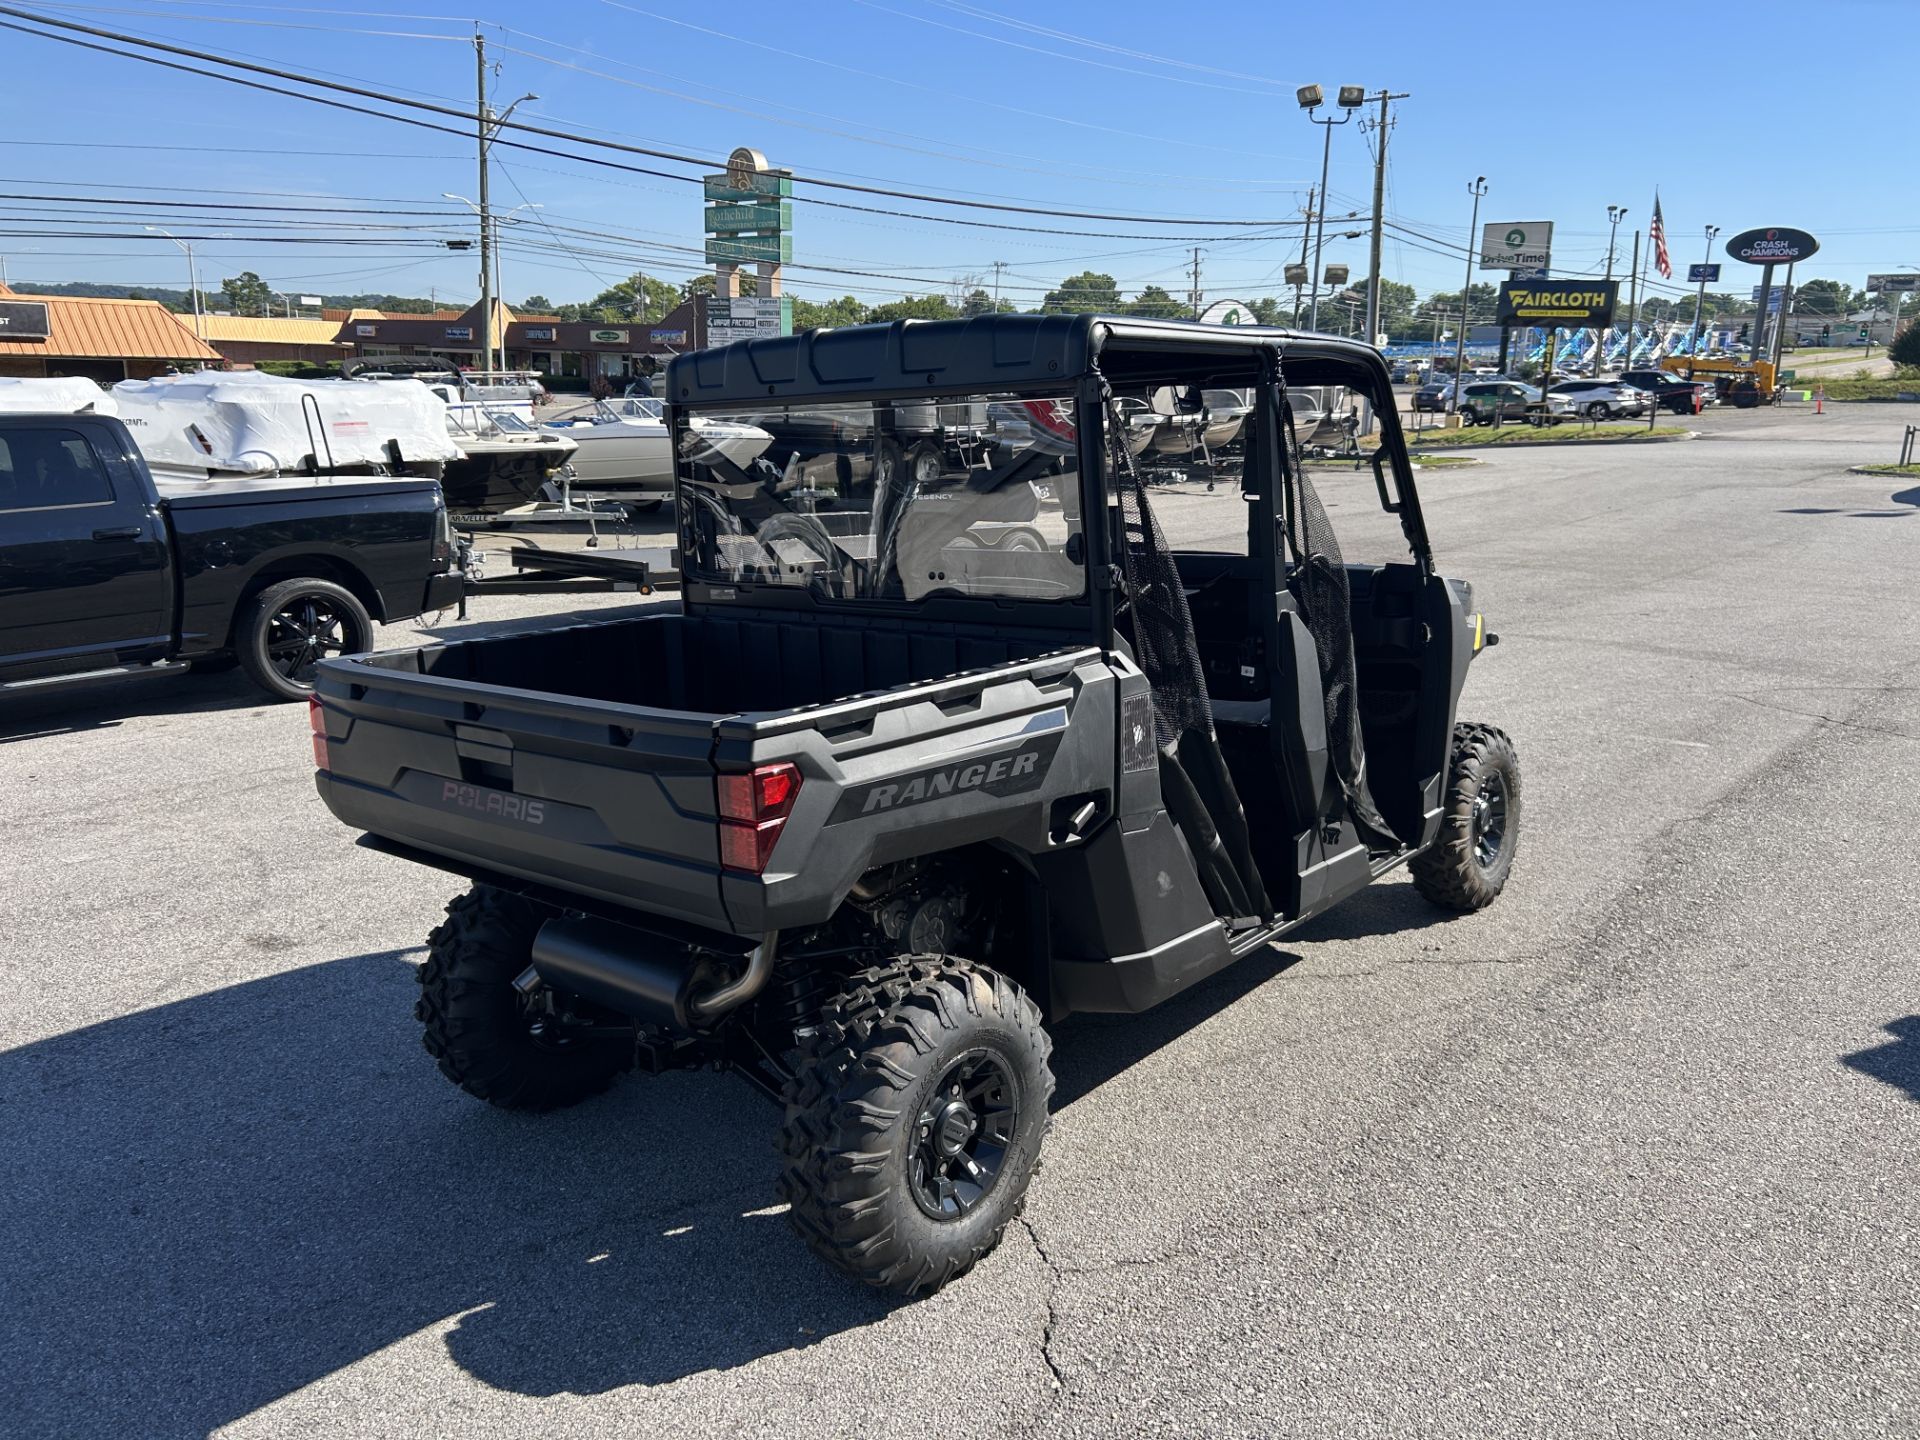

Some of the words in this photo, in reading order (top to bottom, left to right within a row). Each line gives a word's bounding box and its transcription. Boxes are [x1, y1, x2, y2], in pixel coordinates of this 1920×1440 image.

[1754, 241, 1789, 249] CRASH
[1482, 253, 1545, 264] DriveTime
[1741, 248, 1799, 257] CHAMPIONS
[1508, 290, 1605, 307] FAIRCLOTH
[861, 752, 1039, 813] RANGER
[442, 781, 544, 825] POLARIS
